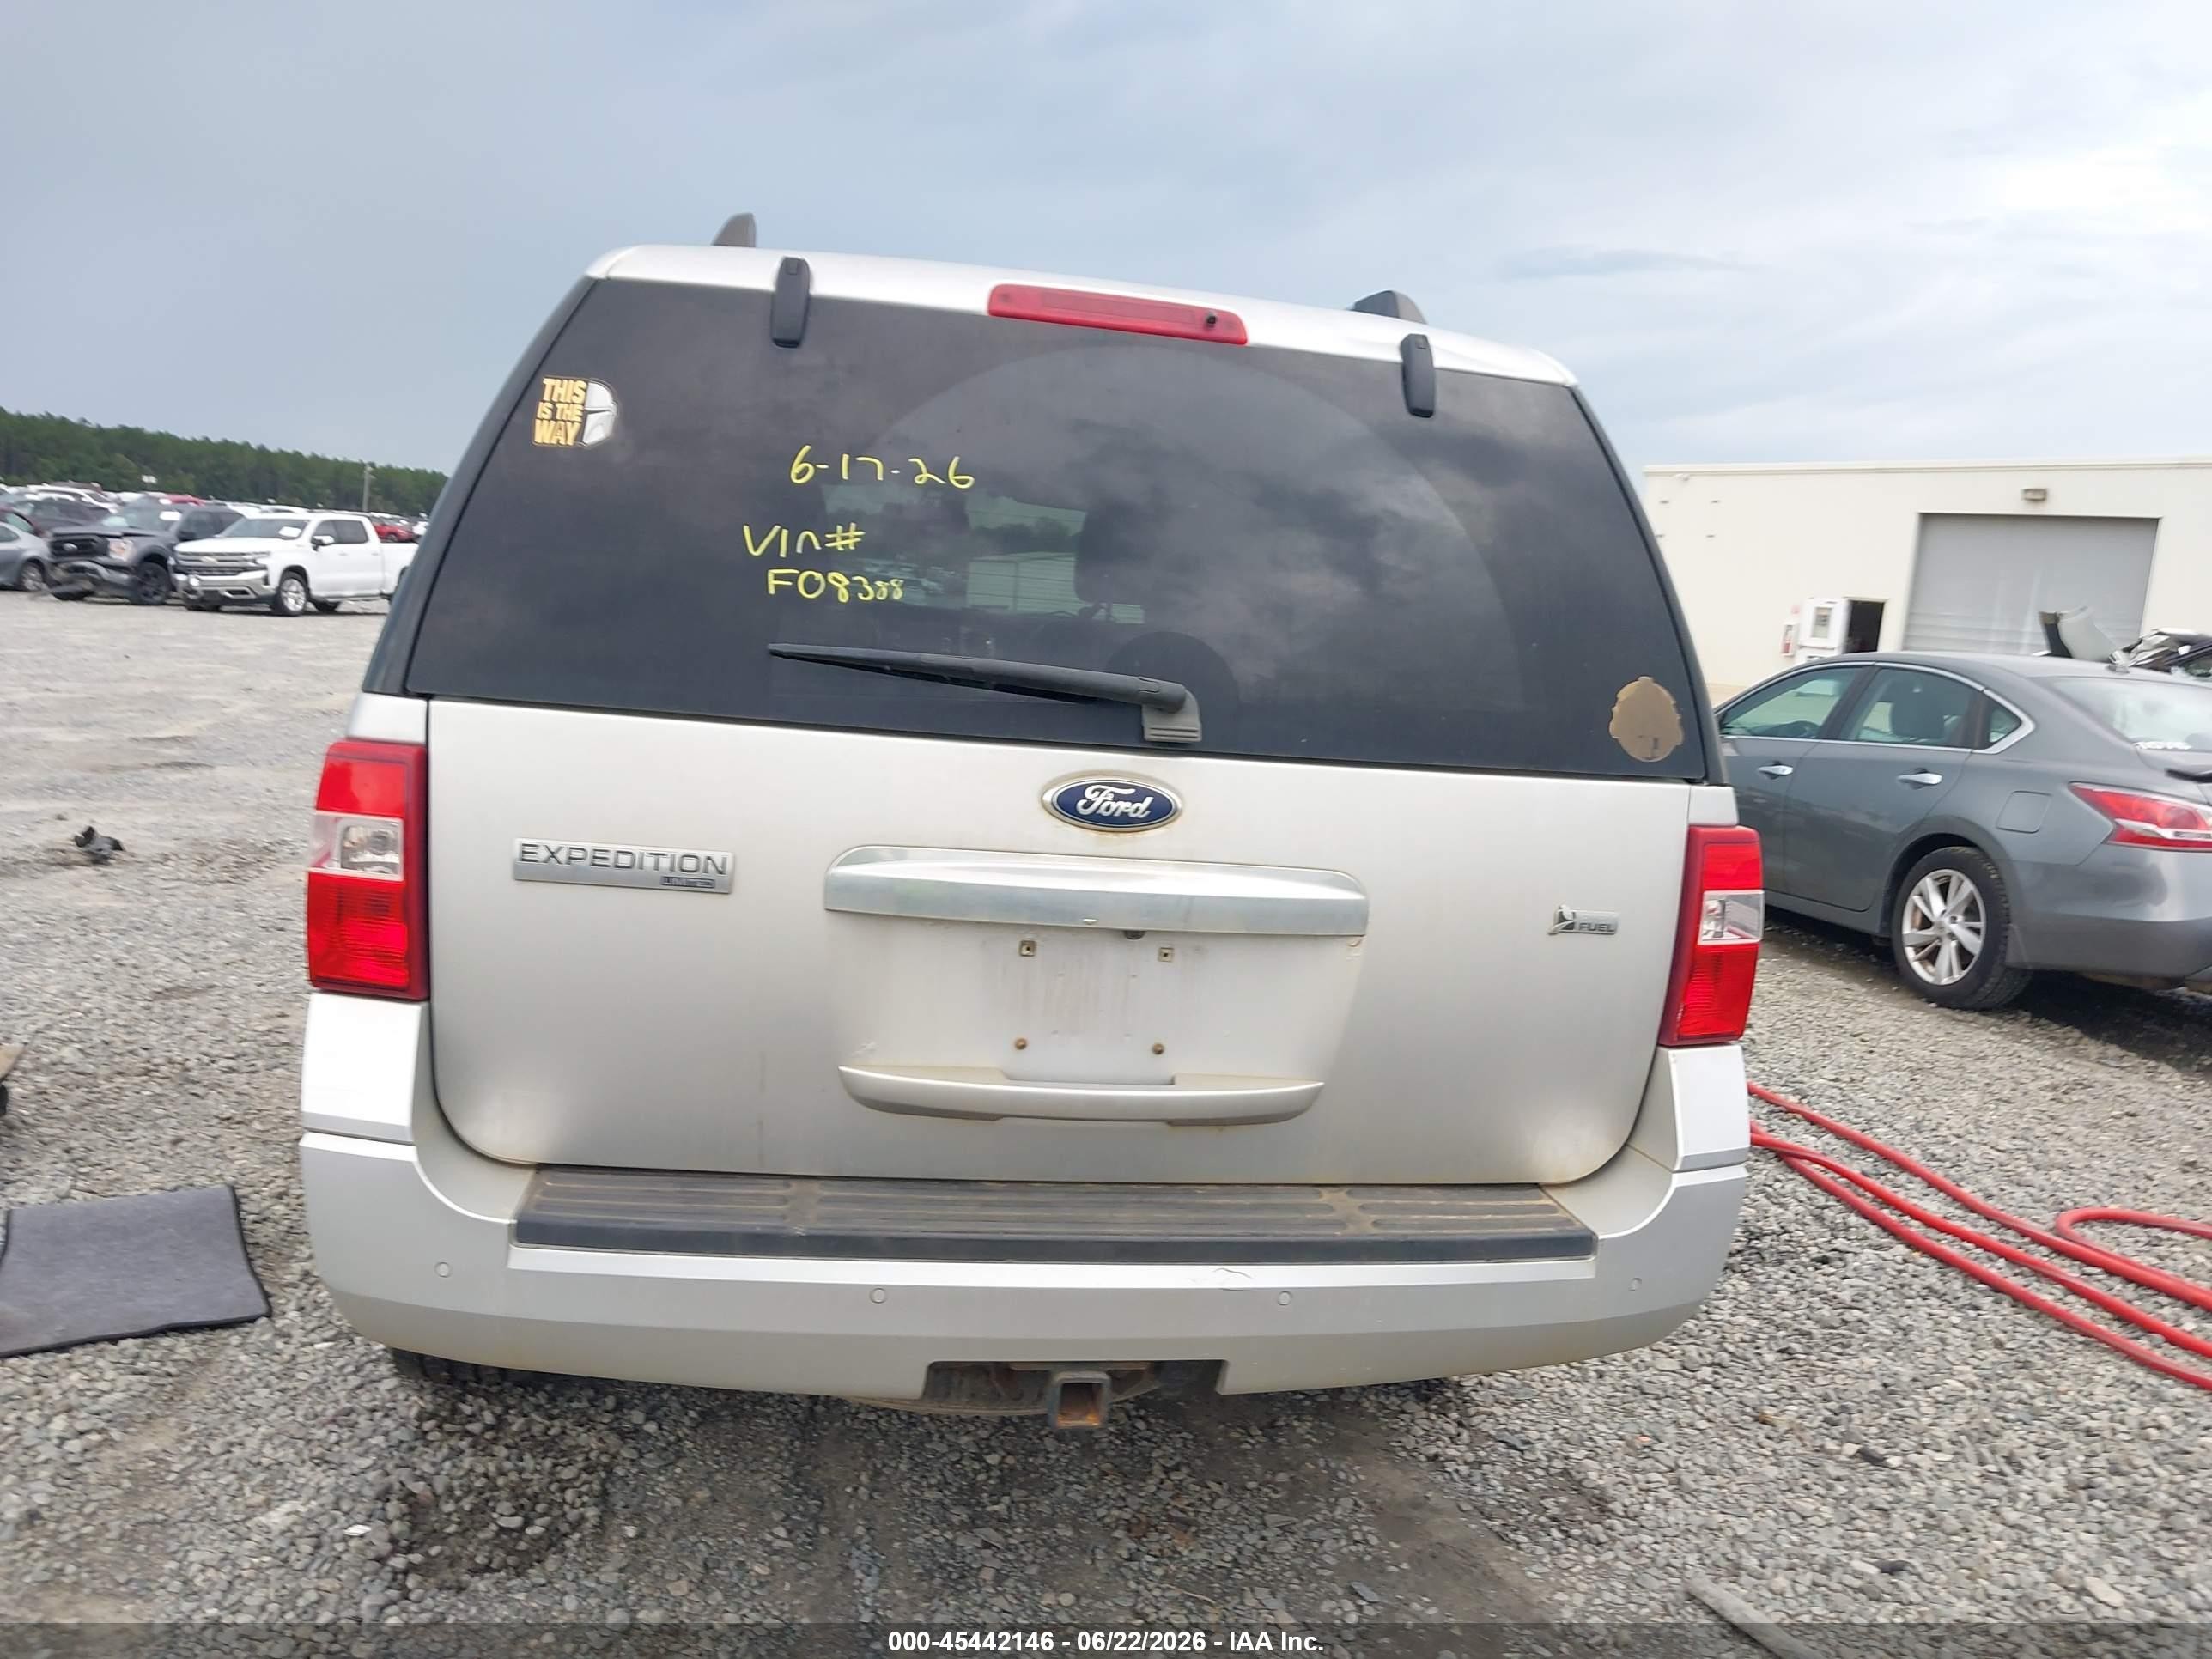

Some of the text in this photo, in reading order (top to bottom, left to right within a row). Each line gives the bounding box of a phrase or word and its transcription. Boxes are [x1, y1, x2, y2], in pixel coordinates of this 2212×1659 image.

[543, 378, 587, 404] THIS
[537, 401, 584, 422] IS THE
[534, 418, 581, 446] WAY
[790, 444, 975, 489] 6-17-26
[1075, 784, 1154, 818] Ford
[519, 842, 728, 876] EXPEDITION
[1579, 922, 1615, 933] FUEL
